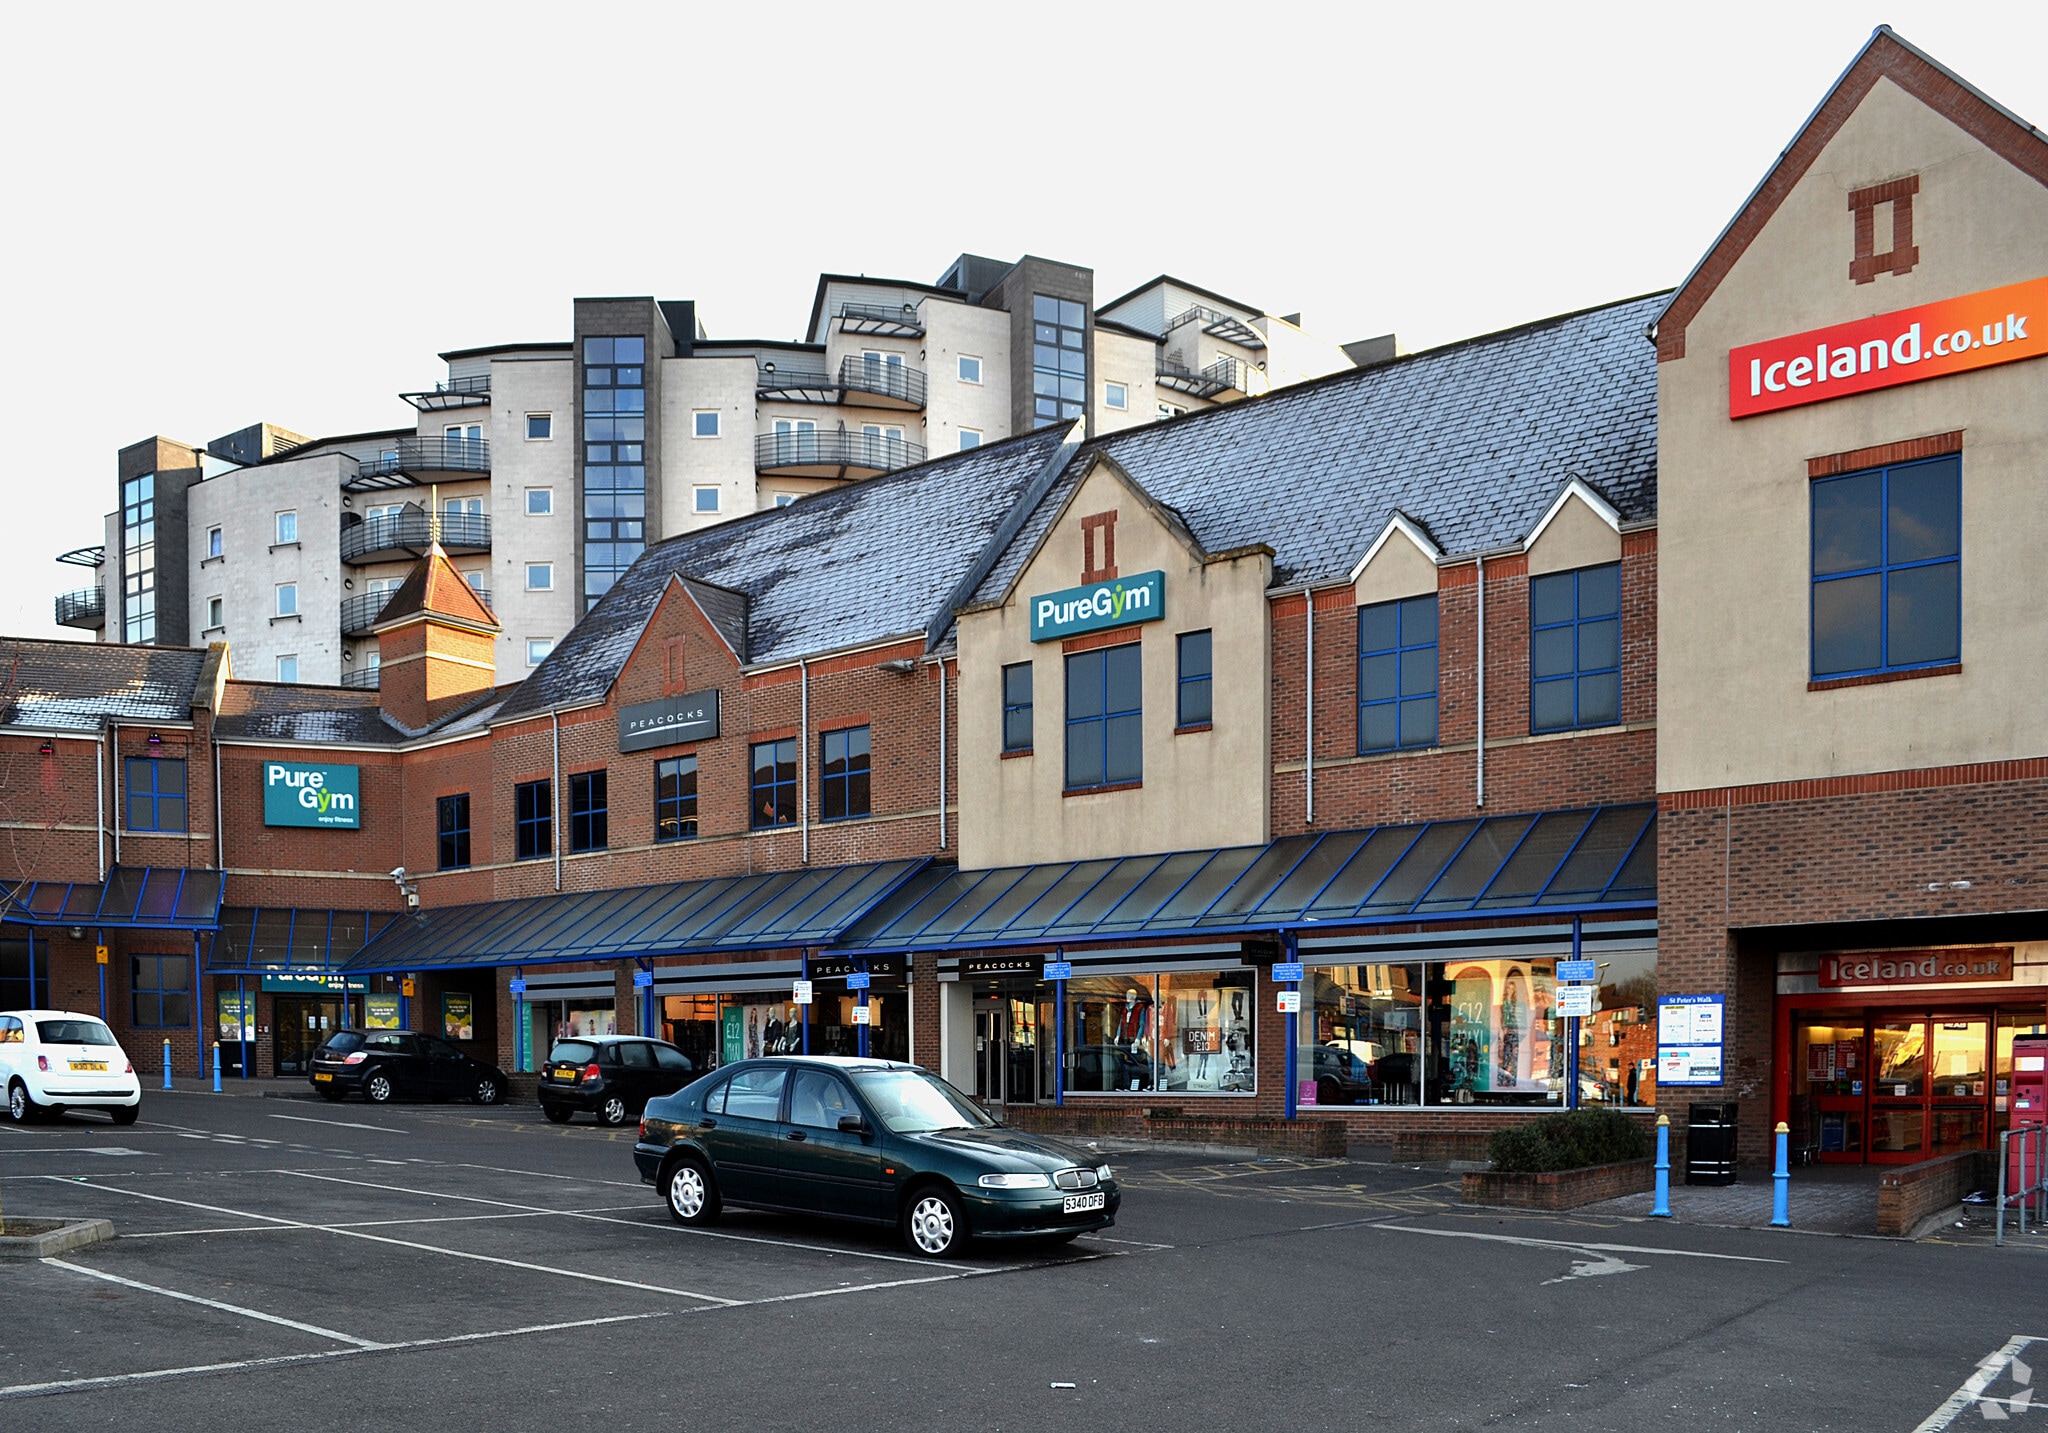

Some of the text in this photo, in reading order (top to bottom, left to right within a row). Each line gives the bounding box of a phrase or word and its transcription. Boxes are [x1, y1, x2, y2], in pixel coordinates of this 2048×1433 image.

[1750, 313, 2028, 397] Iceland.co.uk
[630, 709, 704, 729] PEACOCKS
[268, 765, 324, 788] Pure
[298, 787, 354, 812] Gym
[816, 963, 890, 974] PEACKS
[968, 961, 1032, 970] PEACOCKS
[1830, 956, 2000, 981] Iceland.co.uk
[1188, 1031, 1216, 1042] DENIM
[1065, 1194, 1104, 1210] S340 DFB
